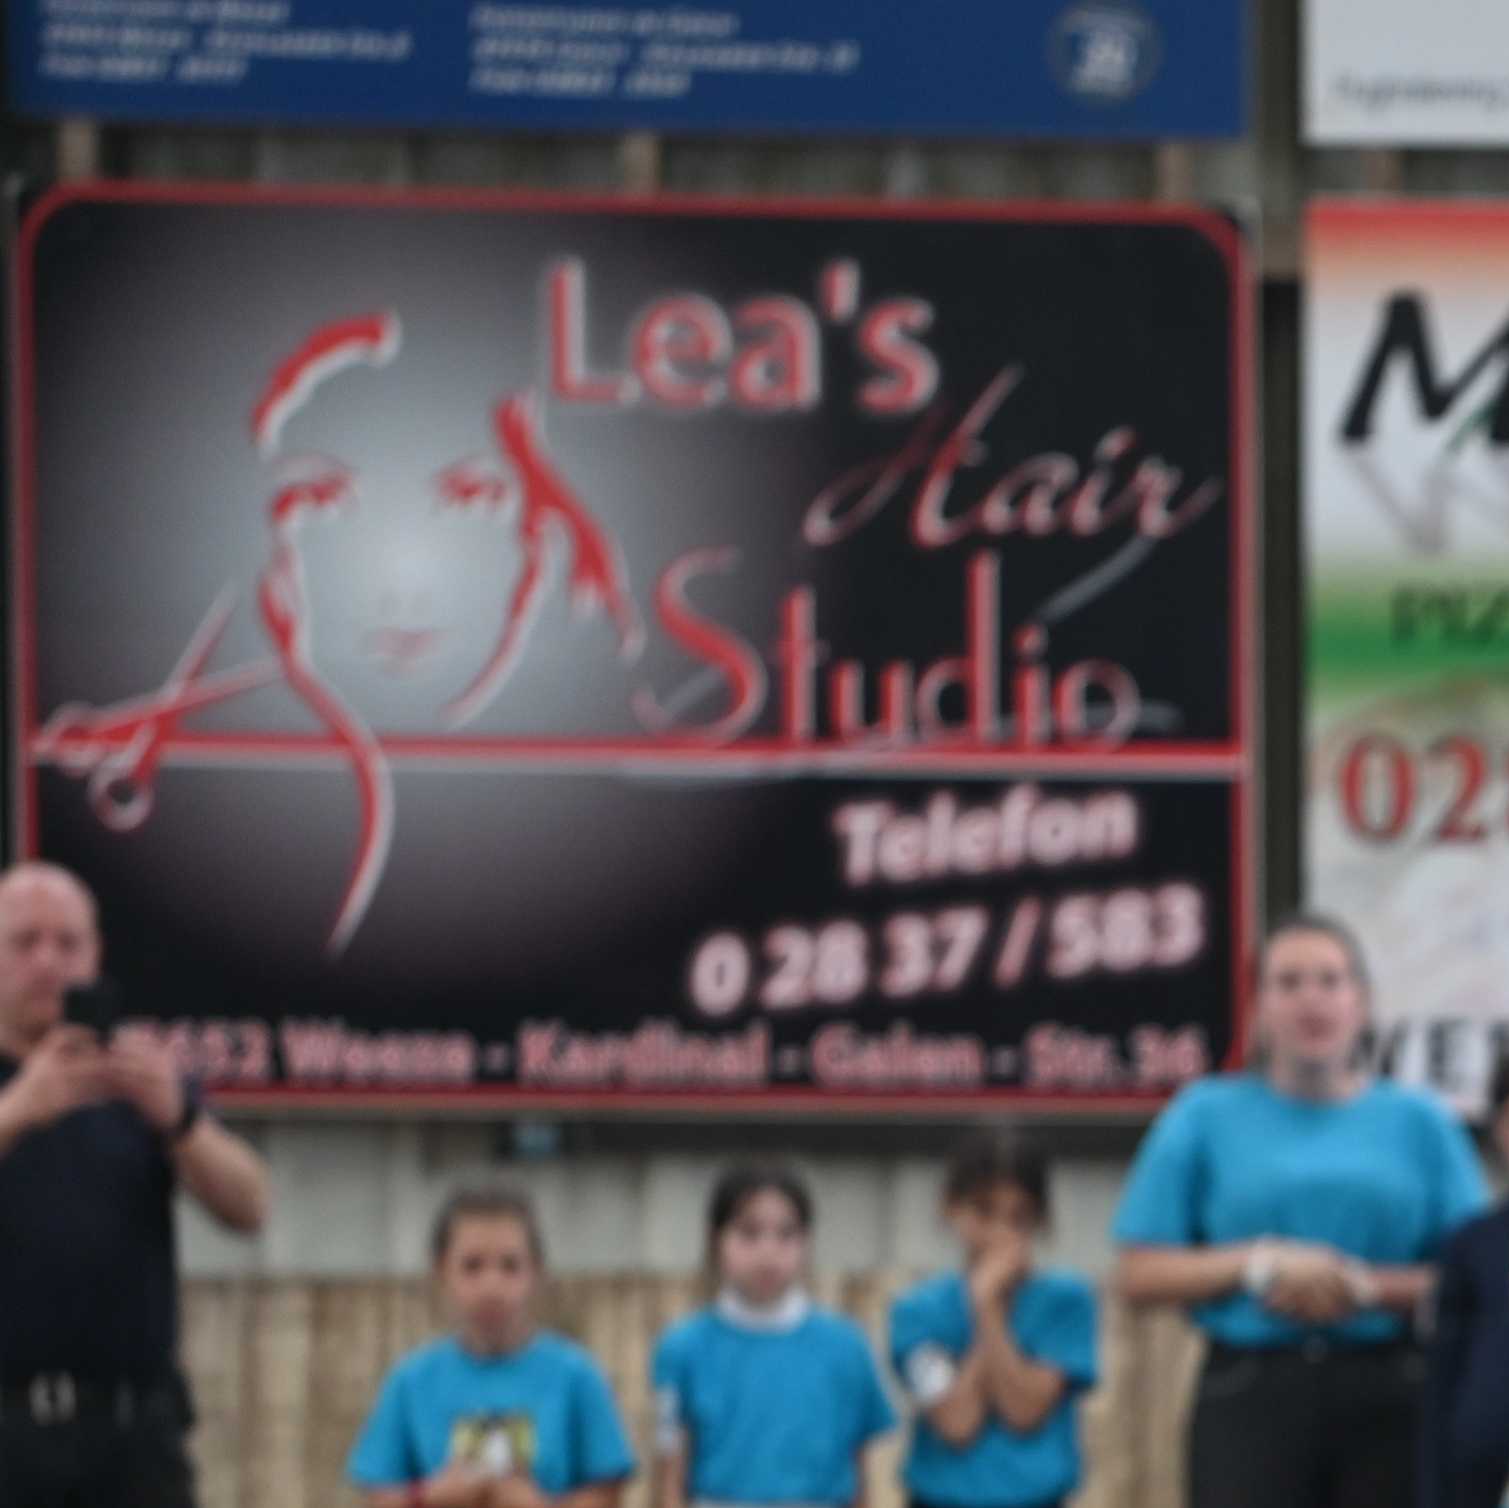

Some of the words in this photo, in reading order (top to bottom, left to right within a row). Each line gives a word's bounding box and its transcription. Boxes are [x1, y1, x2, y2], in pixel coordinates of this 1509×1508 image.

[548, 256, 940, 415] Lea's
[803, 361, 1224, 548] Hair
[632, 545, 1142, 750] Studio
[832, 780, 1140, 887] Telefon
[1047, 880, 1204, 978] 583
[281, 1015, 475, 1082] Weeze
